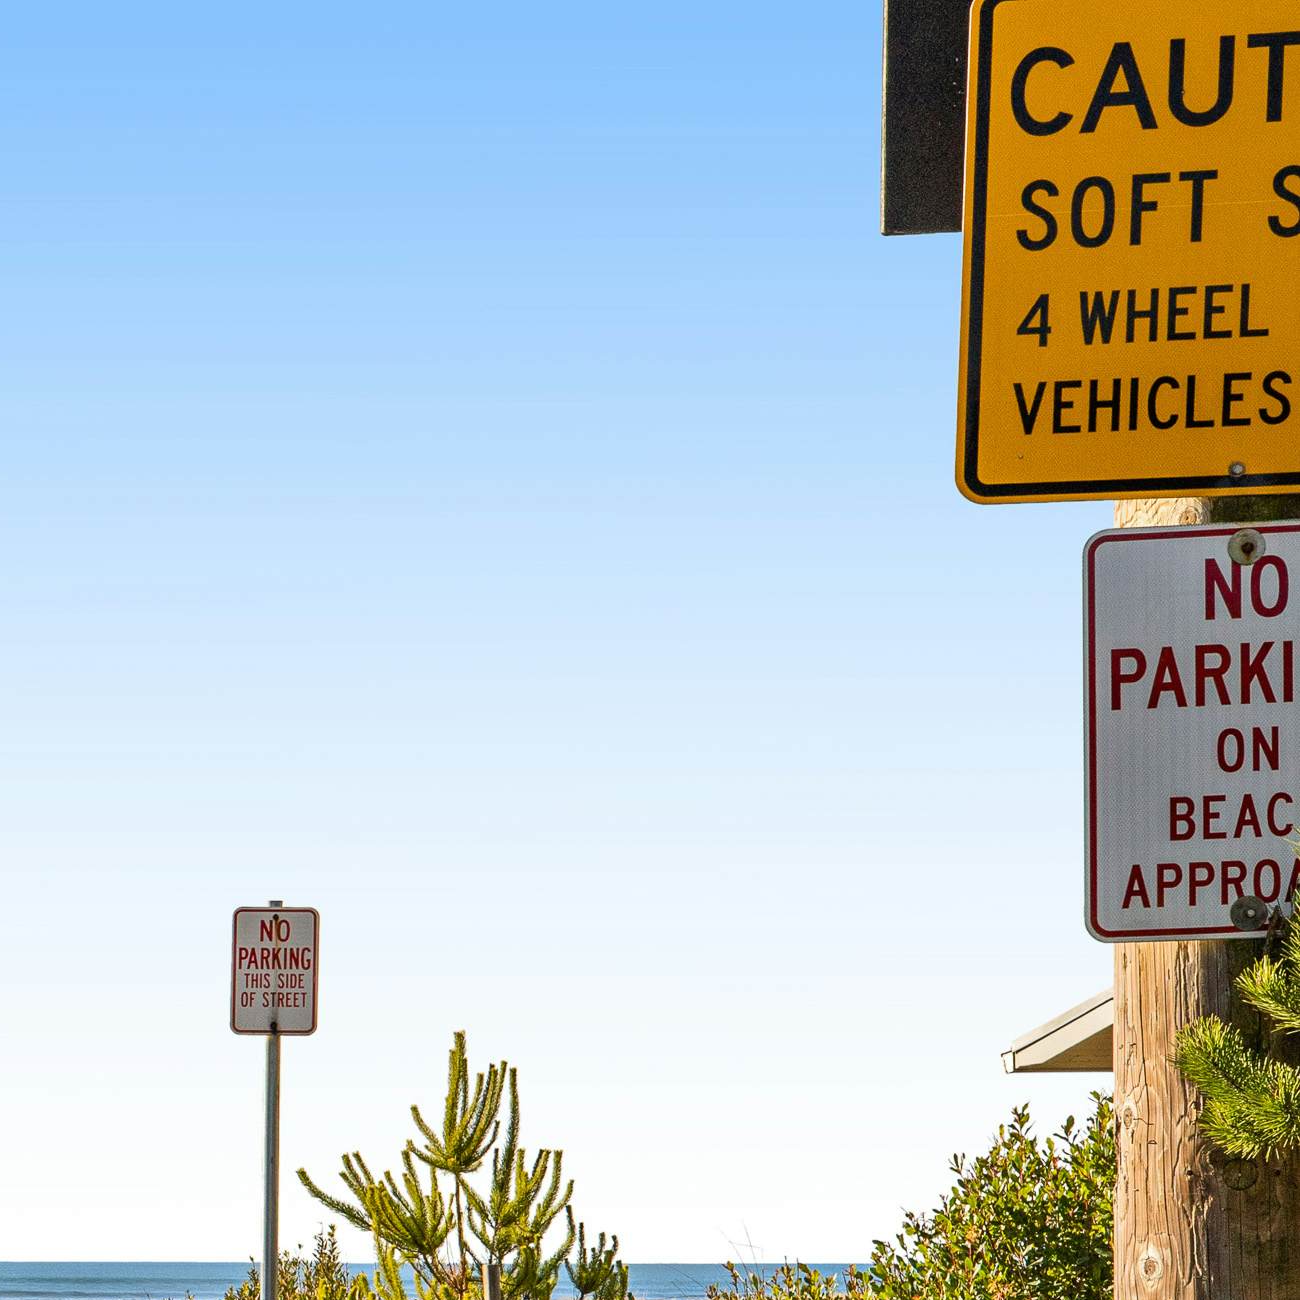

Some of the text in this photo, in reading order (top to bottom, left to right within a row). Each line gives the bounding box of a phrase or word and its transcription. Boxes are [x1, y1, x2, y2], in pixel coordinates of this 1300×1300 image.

[1010, 31, 1300, 137] CAUT
[1016, 169, 1218, 252] SOFT
[1016, 283, 1269, 347] 4 WHEEL
[1013, 370, 1292, 435] VEHICLES
[1204, 555, 1289, 620] NO
[1110, 641, 1294, 711] PARKI
[1217, 726, 1280, 773] ON
[1169, 792, 1293, 841] BEAC
[238, 947, 311, 970] PARKING
[260, 919, 291, 942] NO
[241, 992, 307, 1007] OF STREET
[244, 973, 304, 988] THIS SIDE
